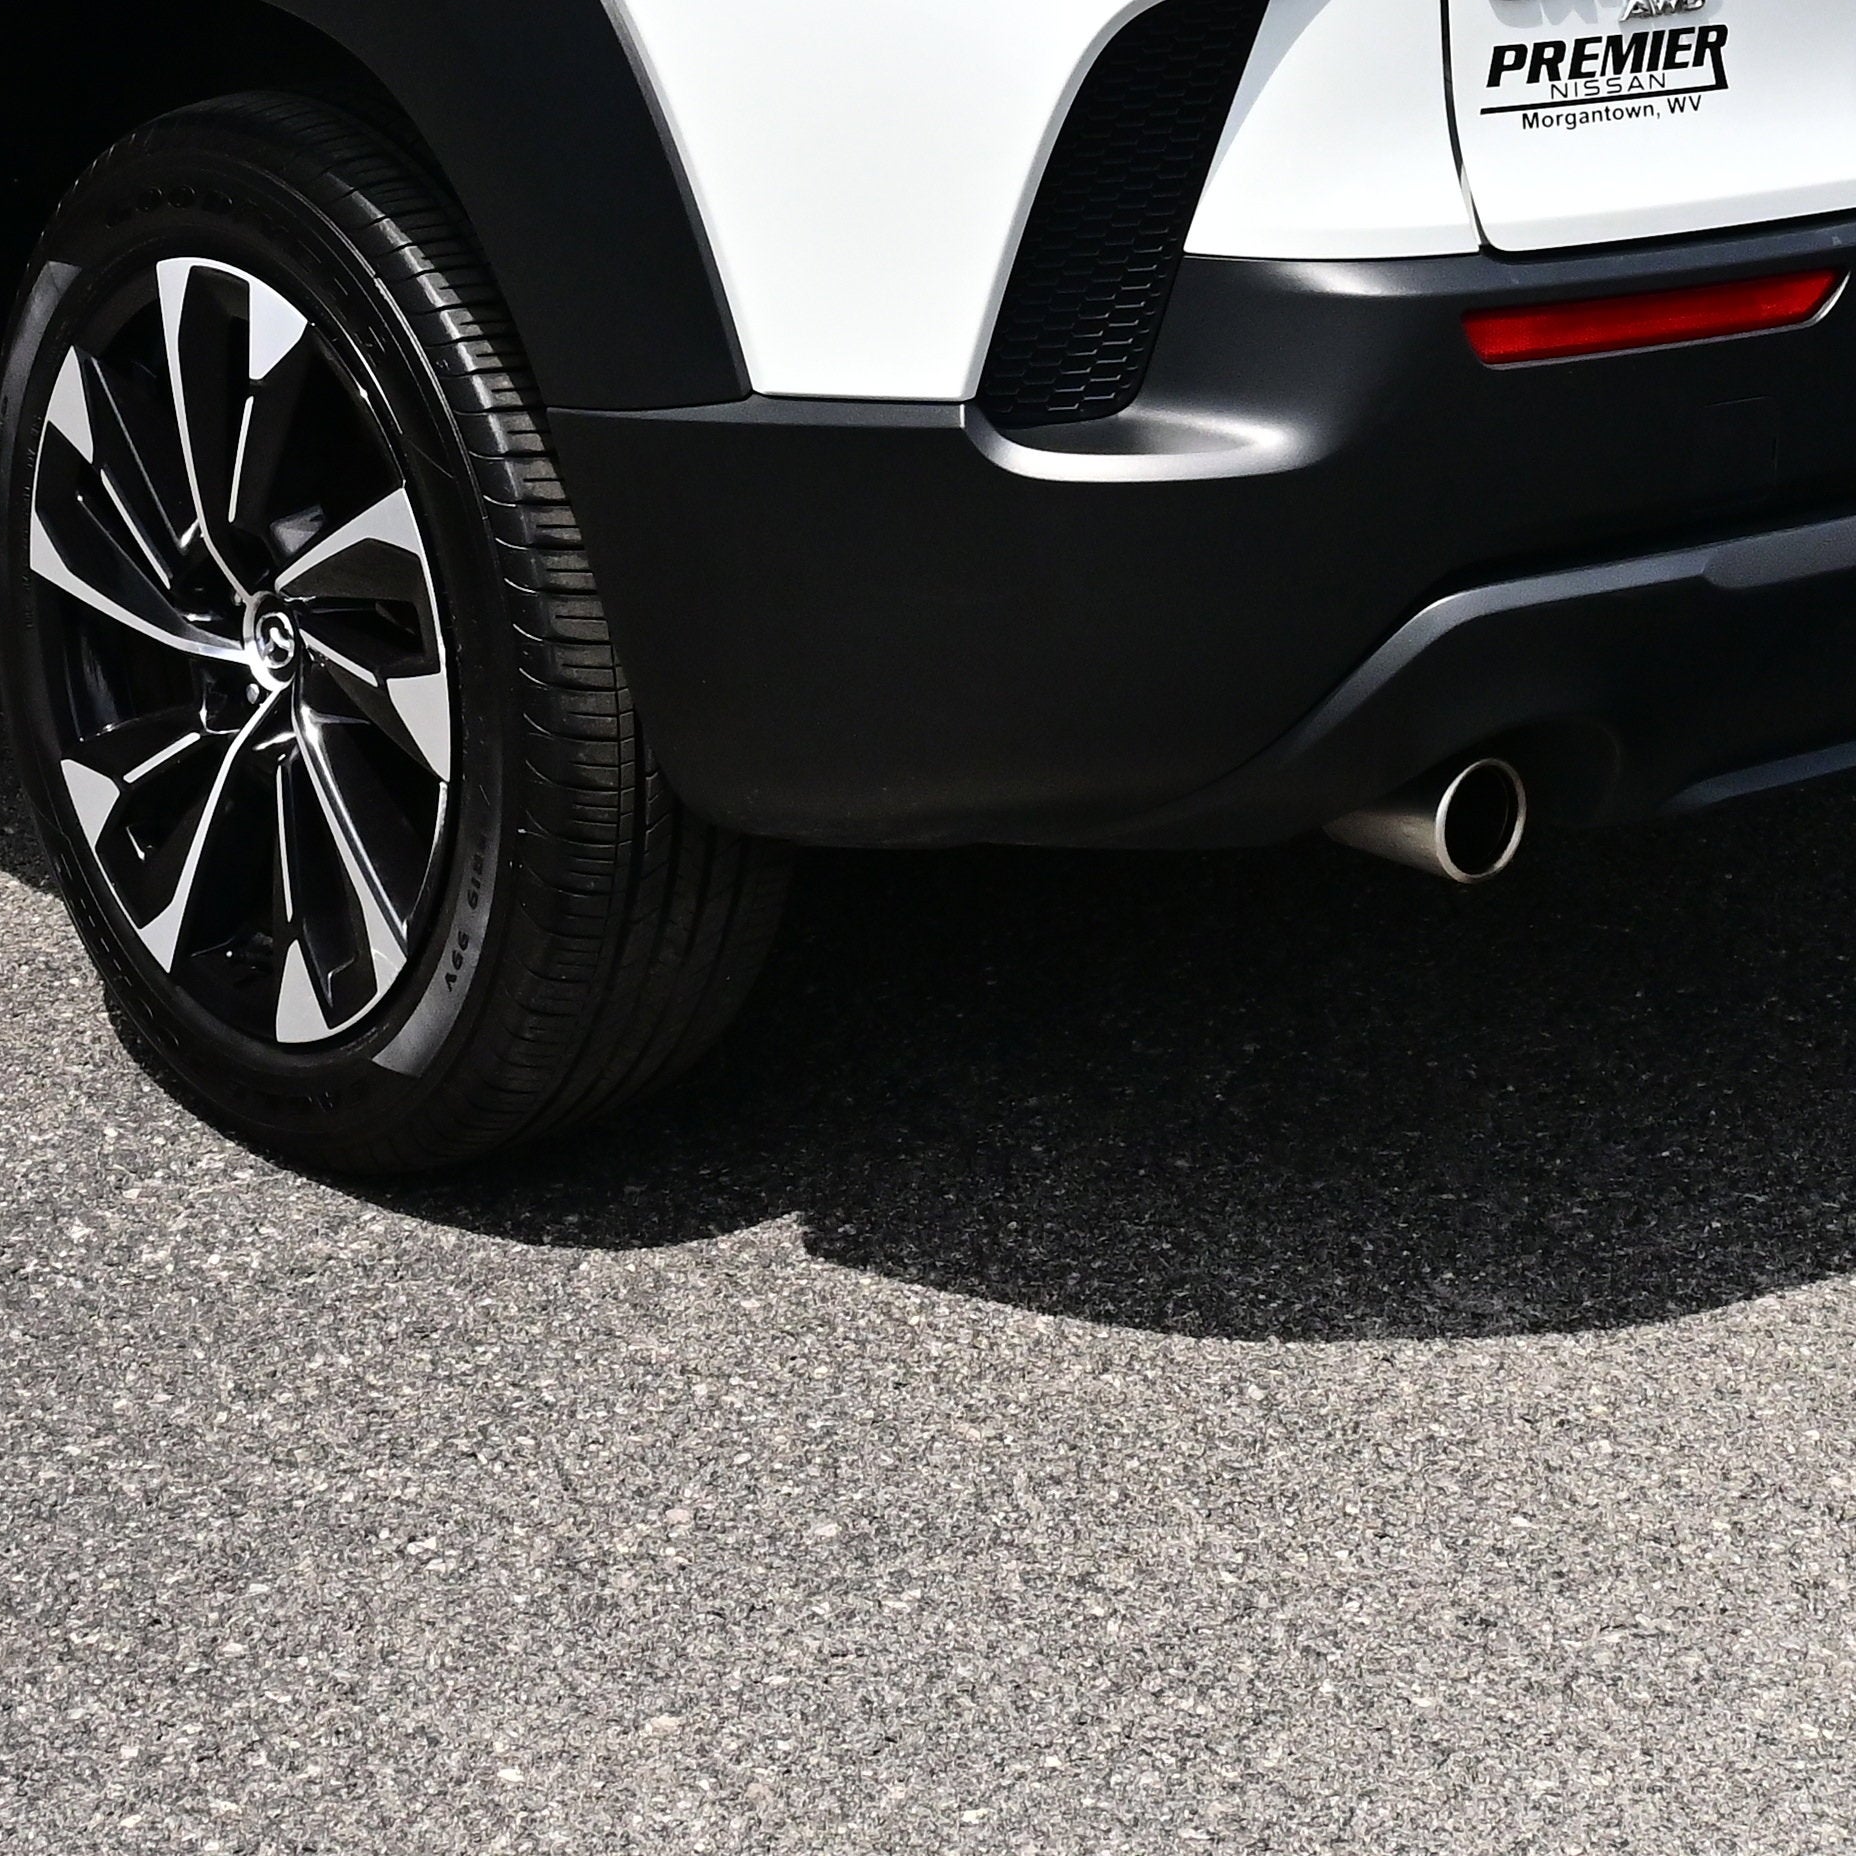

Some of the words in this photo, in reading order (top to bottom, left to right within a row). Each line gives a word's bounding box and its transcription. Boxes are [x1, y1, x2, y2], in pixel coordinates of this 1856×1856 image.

[1486, 24, 1728, 89] PREMIER
[1551, 72, 1665, 99] NISSAN
[1522, 101, 1661, 130] Morgantown,
[1667, 94, 1702, 114] WV
